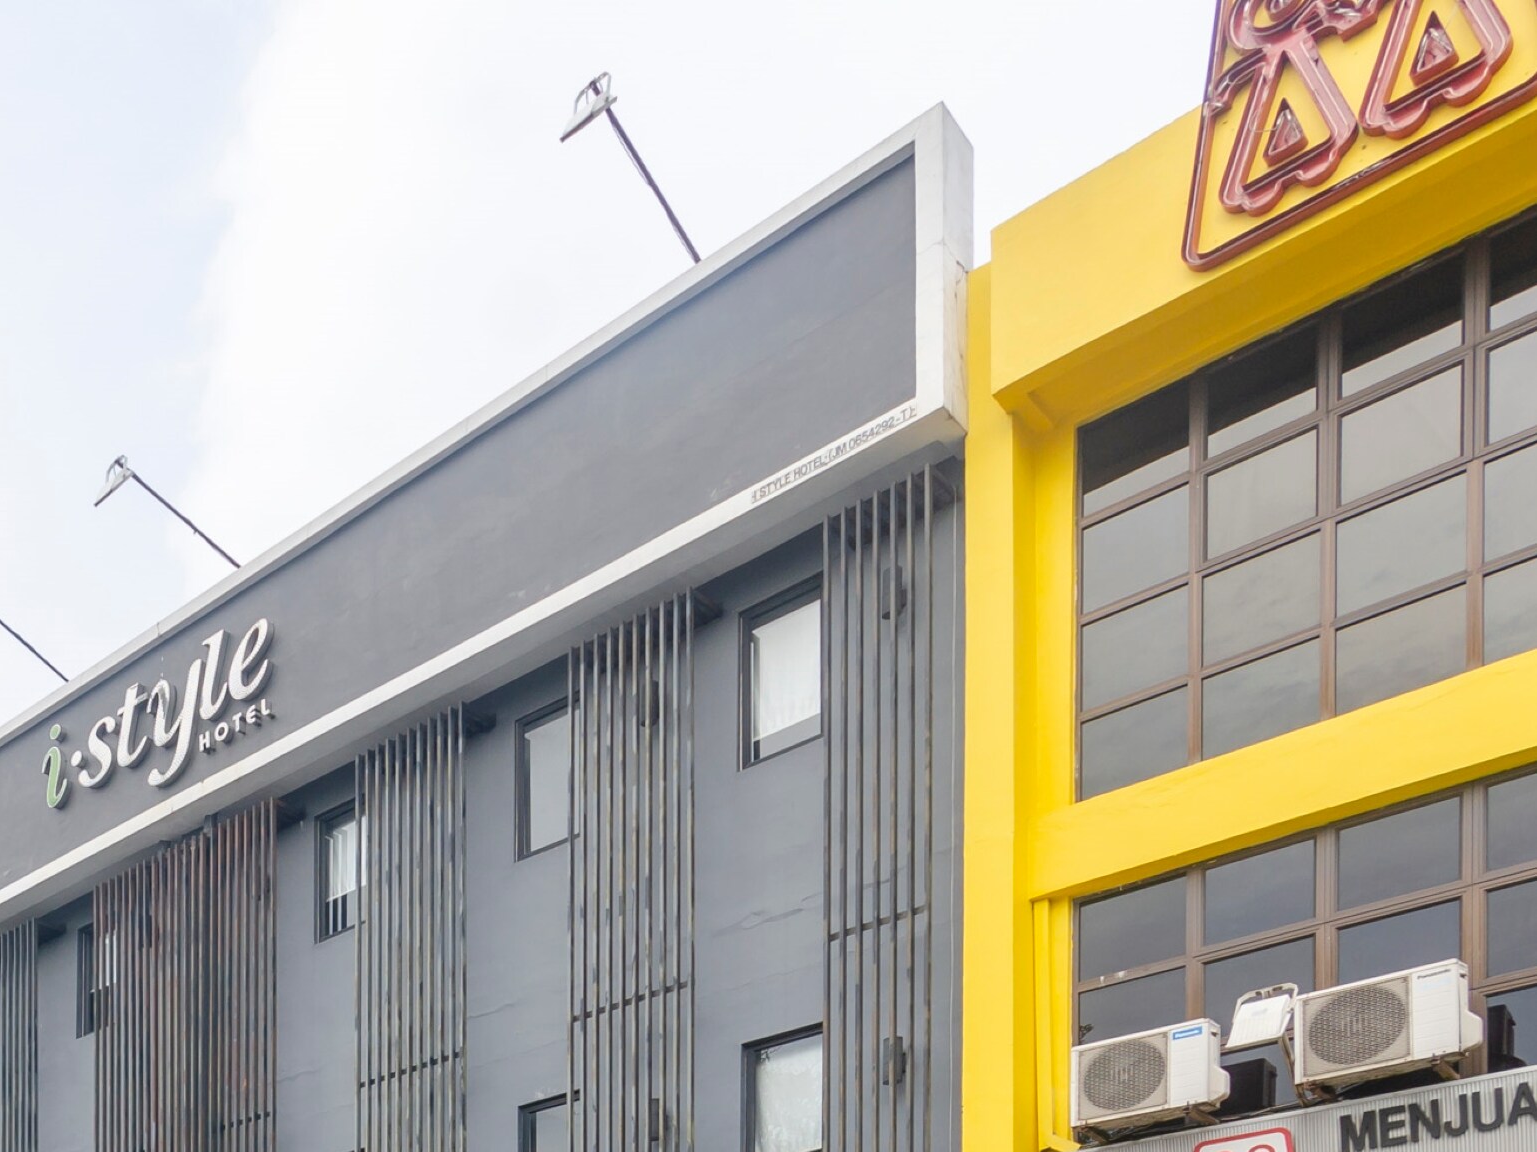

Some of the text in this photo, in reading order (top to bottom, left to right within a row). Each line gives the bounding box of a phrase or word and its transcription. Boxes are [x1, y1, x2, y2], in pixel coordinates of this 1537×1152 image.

[760, 473, 791, 498] STYLE
[794, 457, 825, 480] HOTEL
[199, 699, 273, 753] HOTEL
